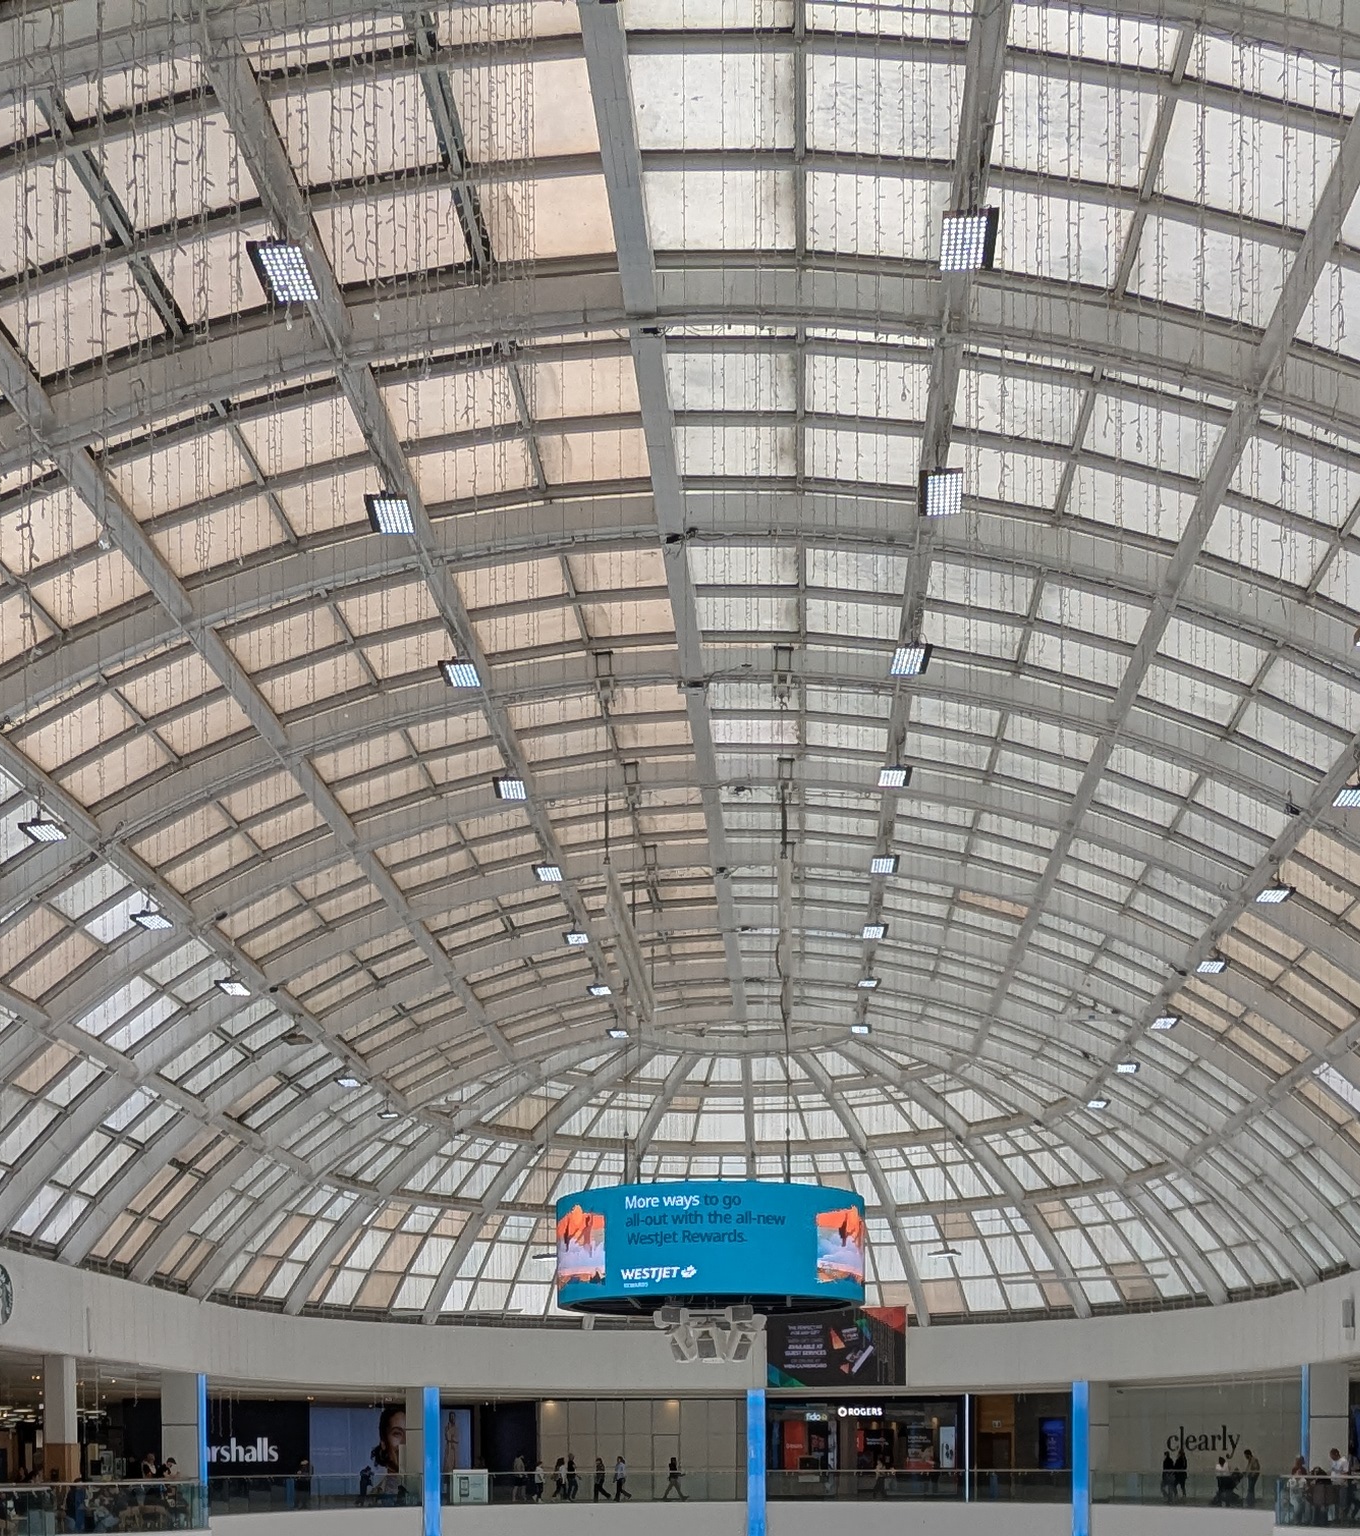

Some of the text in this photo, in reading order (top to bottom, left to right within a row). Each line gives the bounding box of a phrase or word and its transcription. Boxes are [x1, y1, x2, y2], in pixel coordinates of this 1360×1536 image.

[625, 1194, 742, 1210] More ways to go
[625, 1210, 786, 1227] all-out with the all-new
[627, 1231, 679, 1247] WestJet
[620, 1266, 680, 1283] WESTJET
[848, 1406, 883, 1417] ROGERS
[1166, 1425, 1241, 1459] clearly
